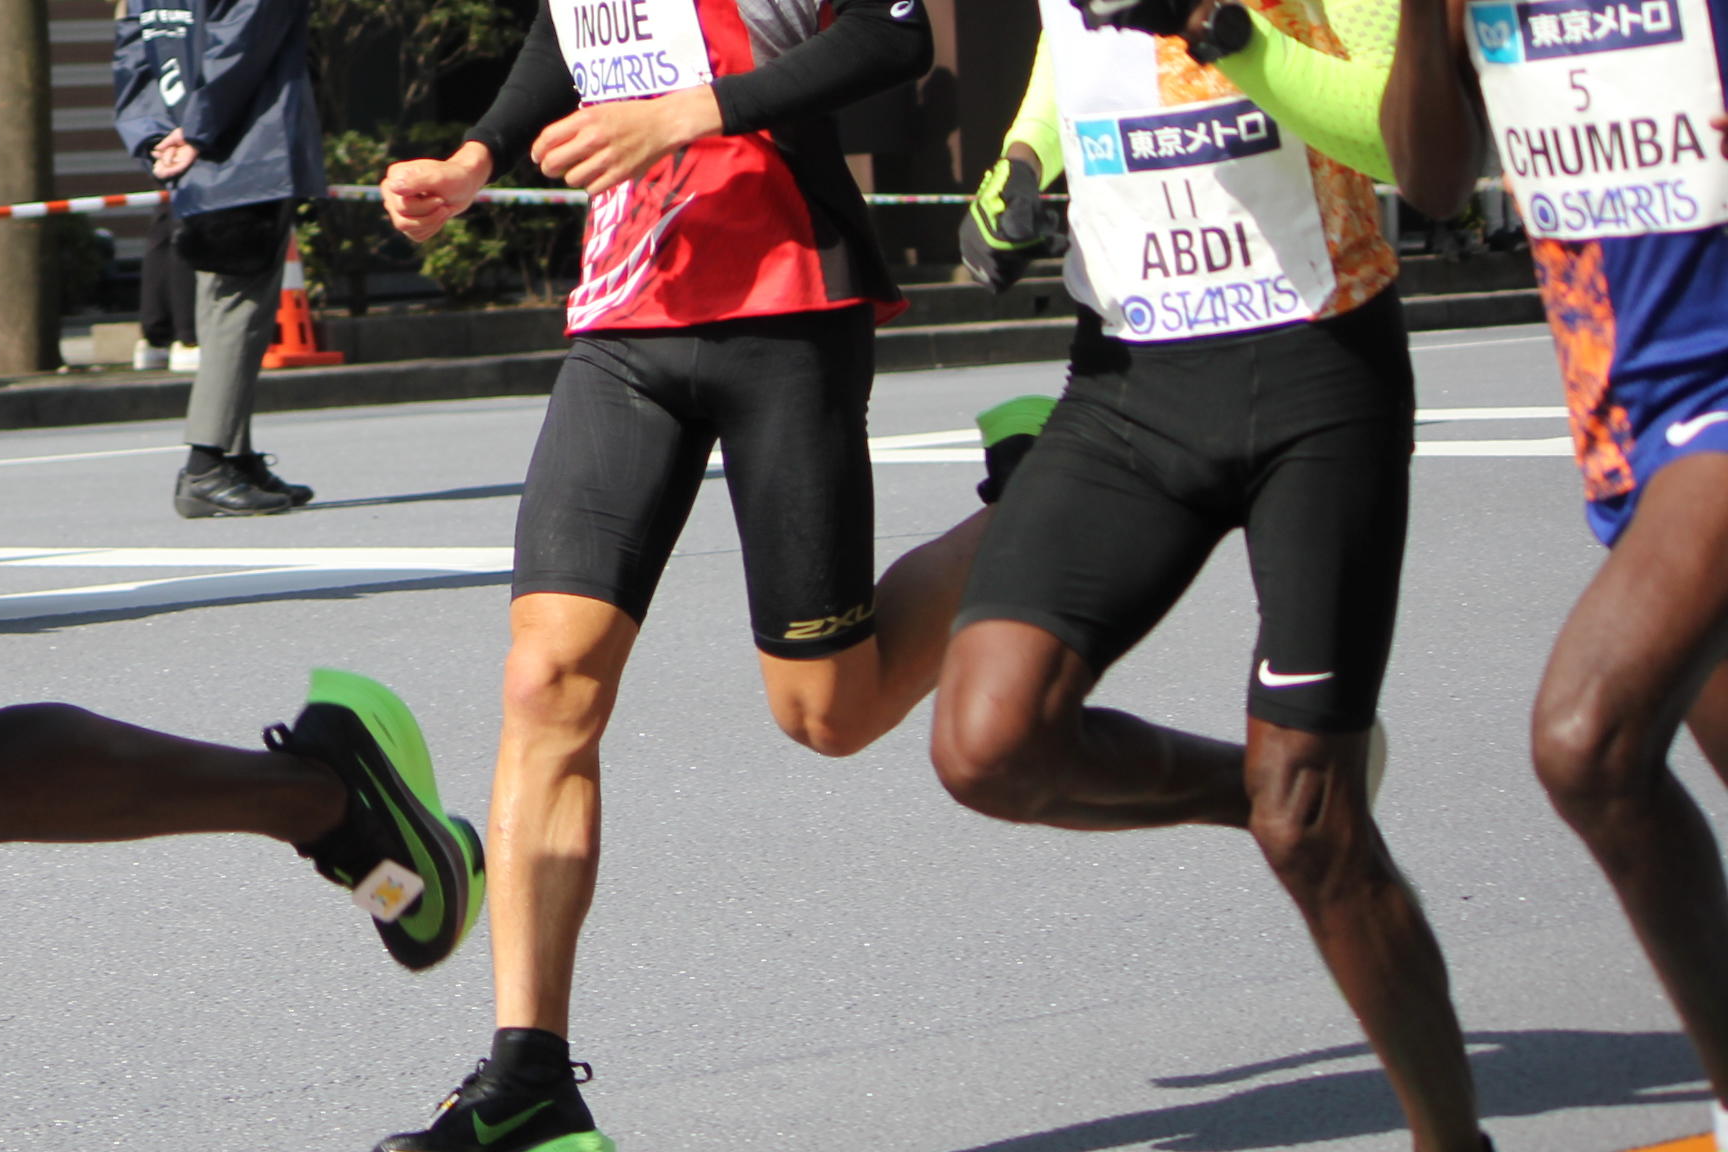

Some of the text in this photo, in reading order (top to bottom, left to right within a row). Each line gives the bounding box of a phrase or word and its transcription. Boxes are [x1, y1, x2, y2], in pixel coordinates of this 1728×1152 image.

[1568, 68, 1592, 113] 5
[1127, 110, 1269, 161] 東京メトロ
[1505, 111, 1707, 179] CHUMBA
[1161, 177, 1198, 221] 11
[1560, 178, 1699, 232] STARTS
[1141, 220, 1253, 282] ABDI
[1160, 273, 1300, 332] STARTS
